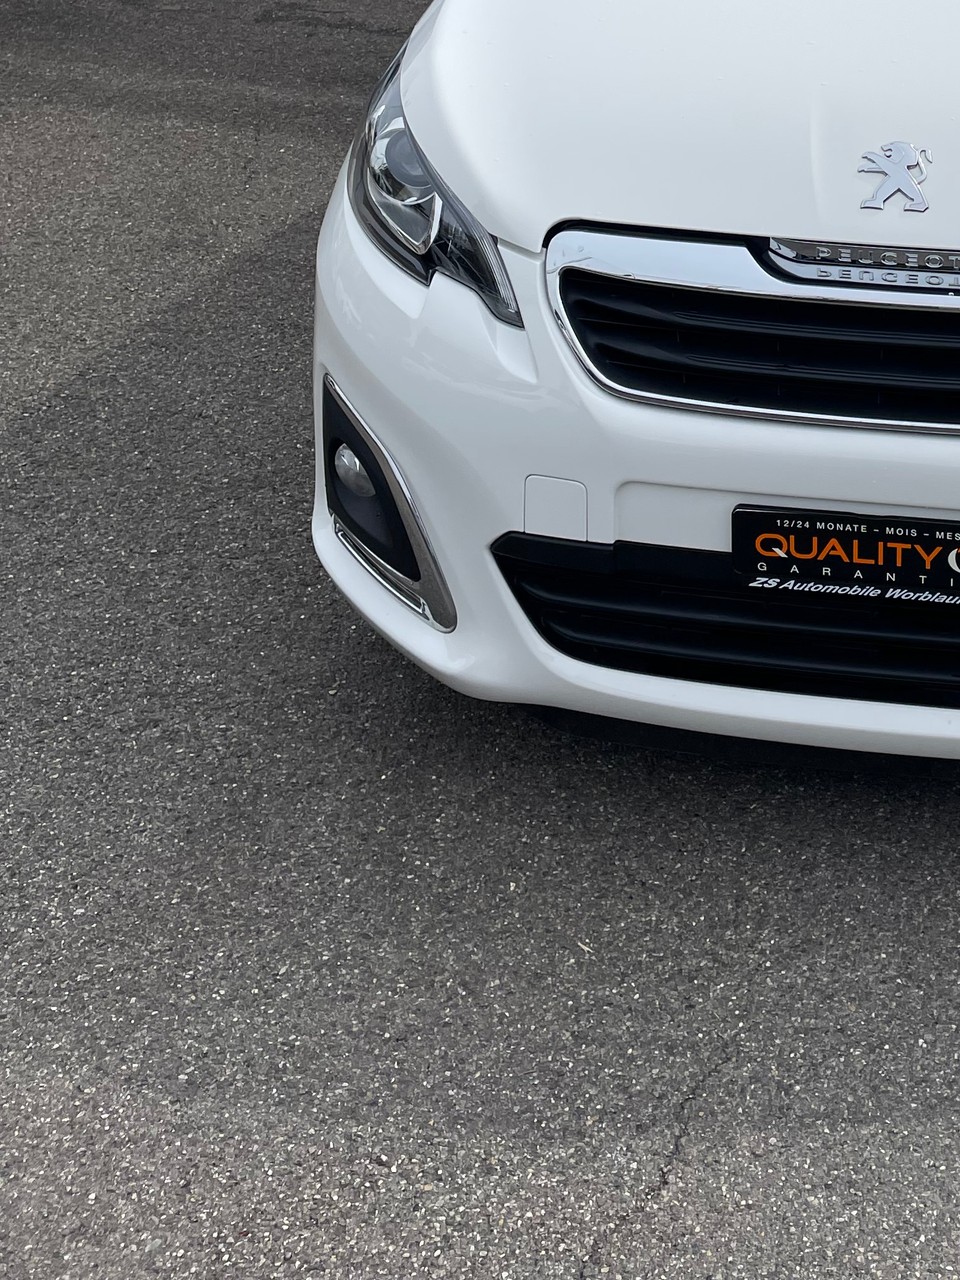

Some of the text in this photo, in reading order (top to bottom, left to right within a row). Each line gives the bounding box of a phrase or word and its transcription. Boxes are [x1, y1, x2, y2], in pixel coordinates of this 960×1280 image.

[776, 519, 811, 529] 12/24
[816, 521, 868, 533] MONATE
[885, 526, 919, 537] MOIS
[755, 533, 943, 570] QUALITY
[748, 577, 781, 588] ZS
[778, 578, 882, 597] Automobile
